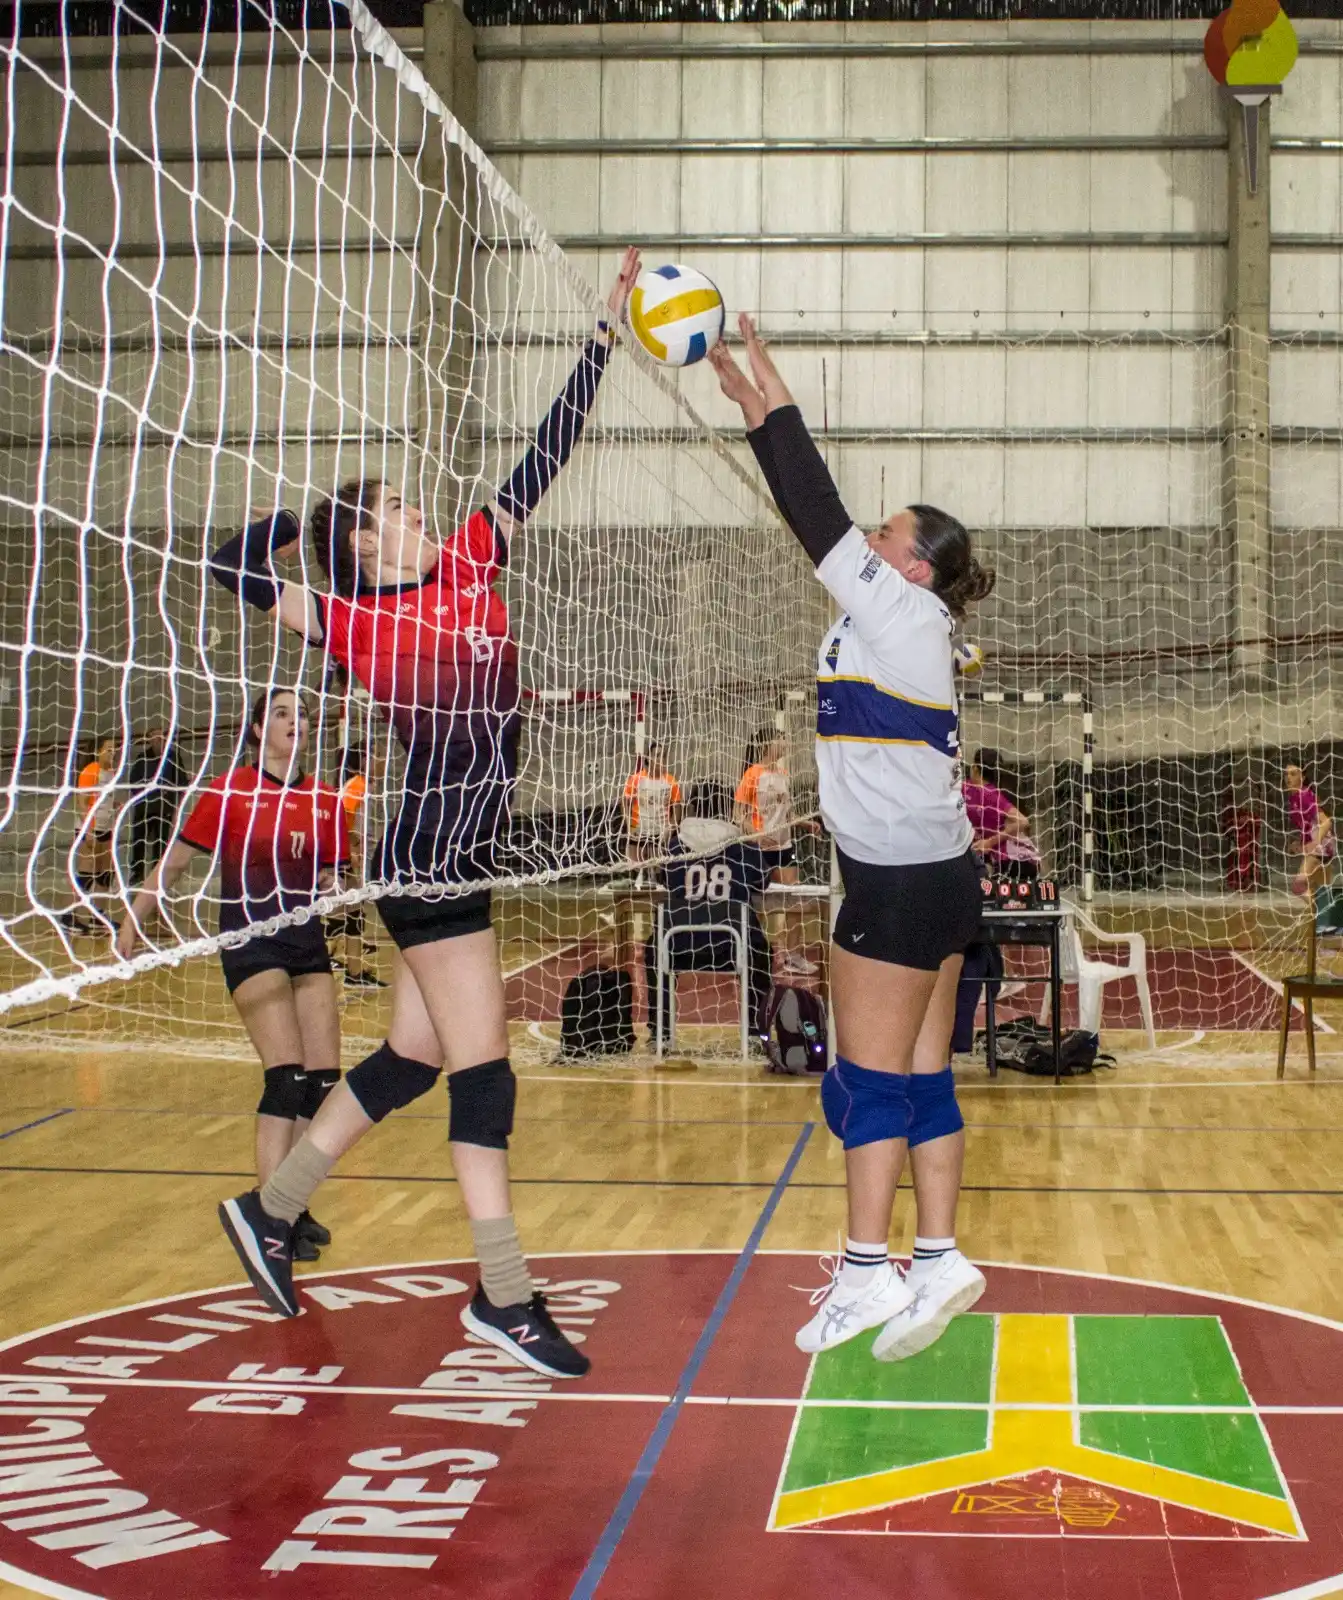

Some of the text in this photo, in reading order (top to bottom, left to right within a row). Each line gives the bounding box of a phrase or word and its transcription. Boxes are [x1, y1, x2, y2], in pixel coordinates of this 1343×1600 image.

[684, 864, 733, 901] 08
[187, 1362, 345, 1416] DE
[260, 1446, 500, 1575] TRES
